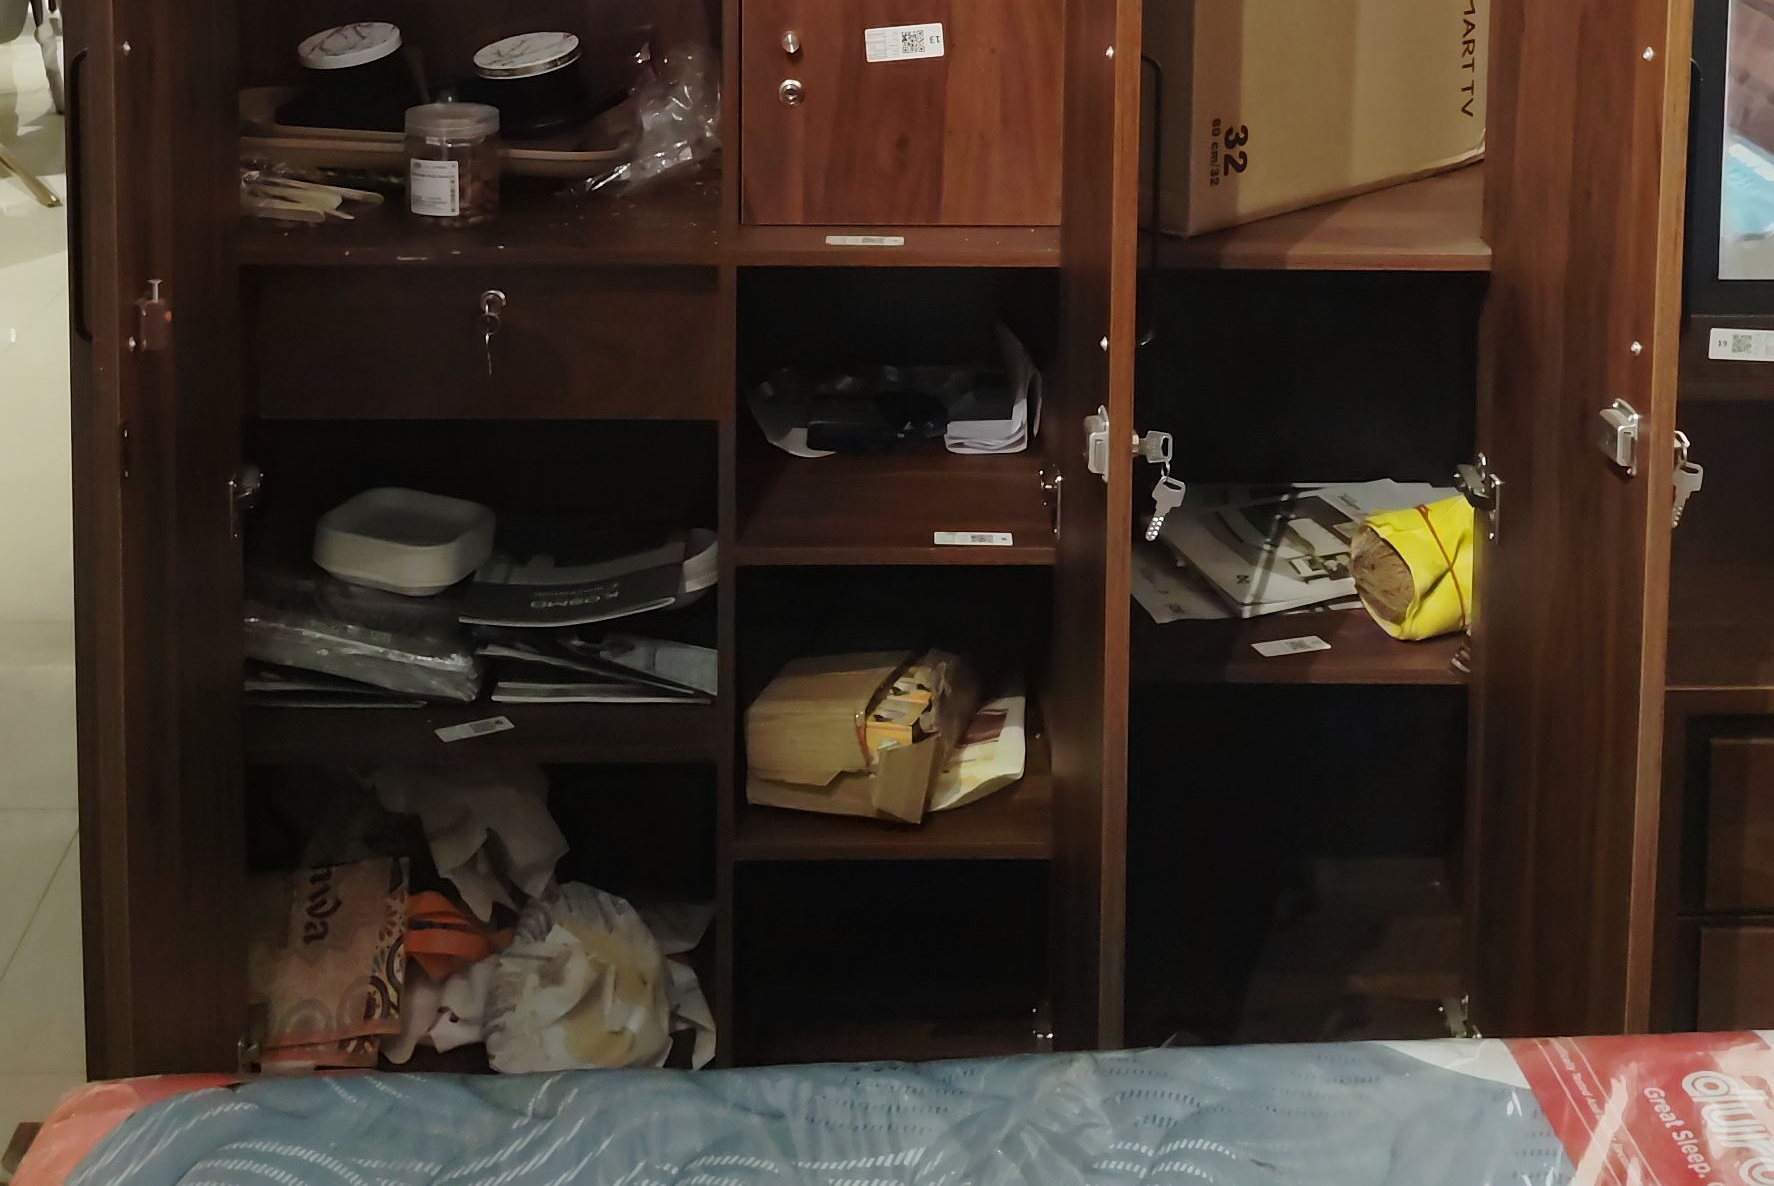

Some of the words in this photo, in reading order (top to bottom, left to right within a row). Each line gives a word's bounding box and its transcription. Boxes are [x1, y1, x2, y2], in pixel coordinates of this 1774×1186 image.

[929, 34, 941, 45] 13
[1460, 79, 1475, 118] TV
[1223, 125, 1249, 176] 32
[1643, 1087, 1685, 1129] Great
[1671, 1129, 1711, 1179] Sleep.
